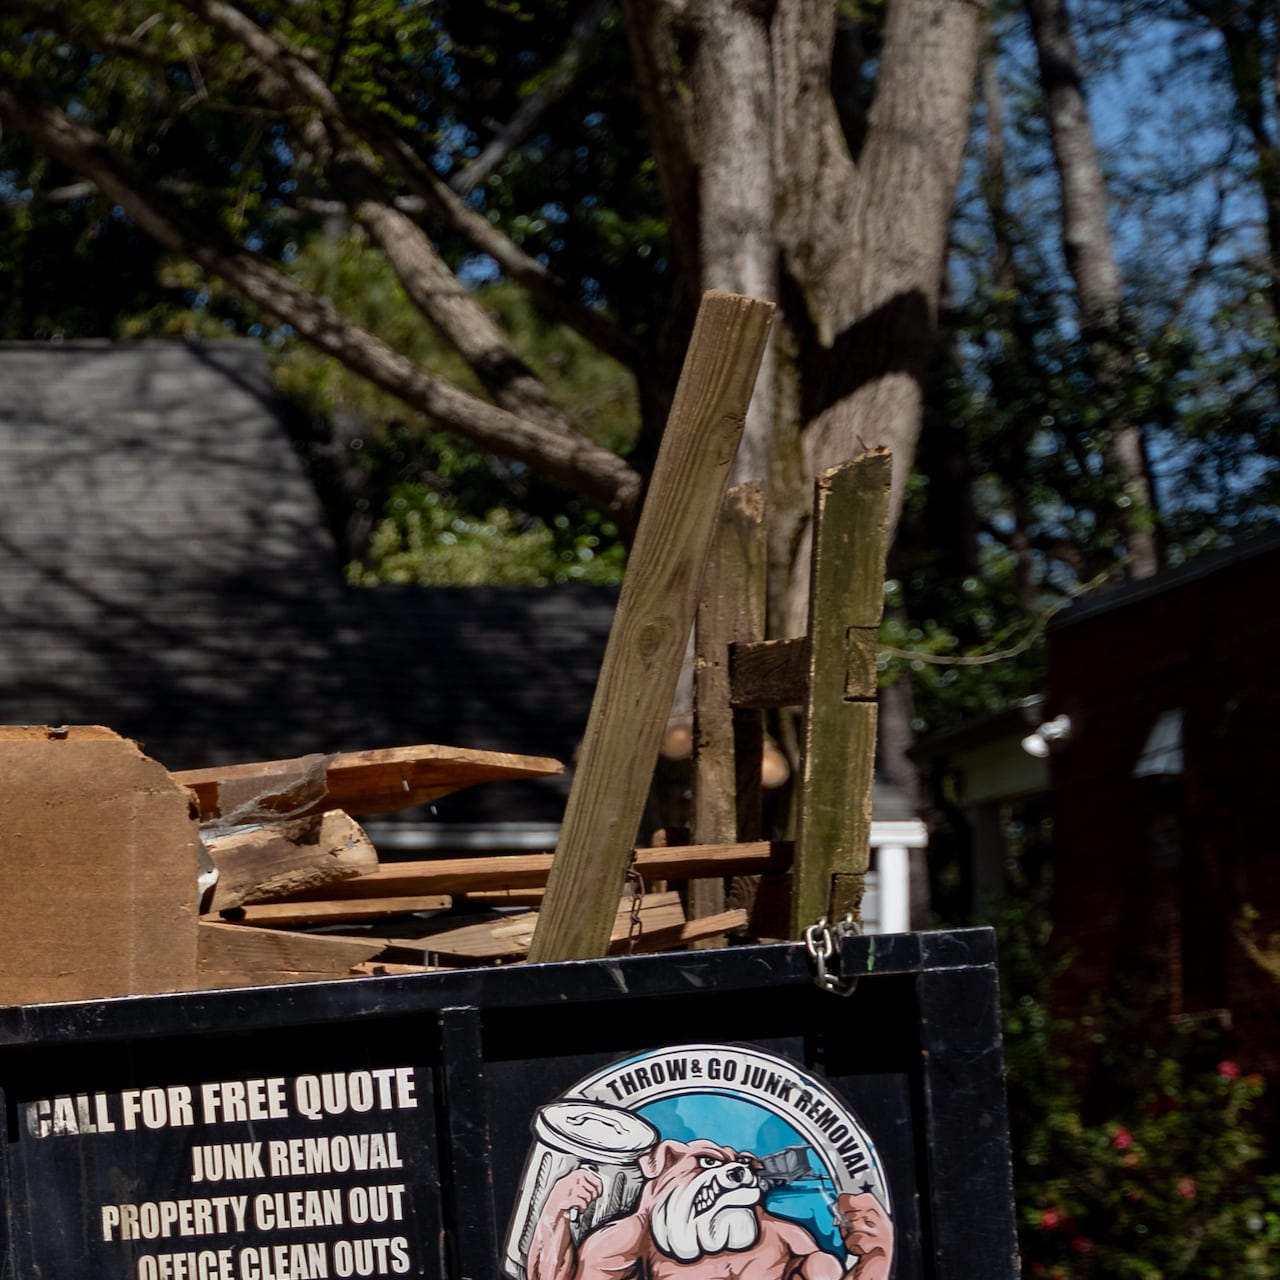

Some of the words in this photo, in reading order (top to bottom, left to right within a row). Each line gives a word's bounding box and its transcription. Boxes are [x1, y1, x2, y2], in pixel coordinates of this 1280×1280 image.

[26, 1093, 115, 1138] CALL
[121, 1085, 194, 1131] FOR
[201, 1077, 288, 1124] FREE
[296, 1067, 418, 1120] QUOTE
[606, 1058, 688, 1101] THROW
[691, 1059, 703, 1078] &
[707, 1057, 738, 1082] GO
[740, 1063, 797, 1103] JUNK
[793, 1088, 872, 1180] REMOVAL
[191, 1141, 266, 1182] JUNK
[269, 1132, 403, 1176] REMOVAL
[102, 1196, 248, 1242] PROPERTY
[255, 1189, 343, 1231] CLEAN
[349, 1184, 405, 1223] OUT
[335, 1237, 410, 1277] OUTS
